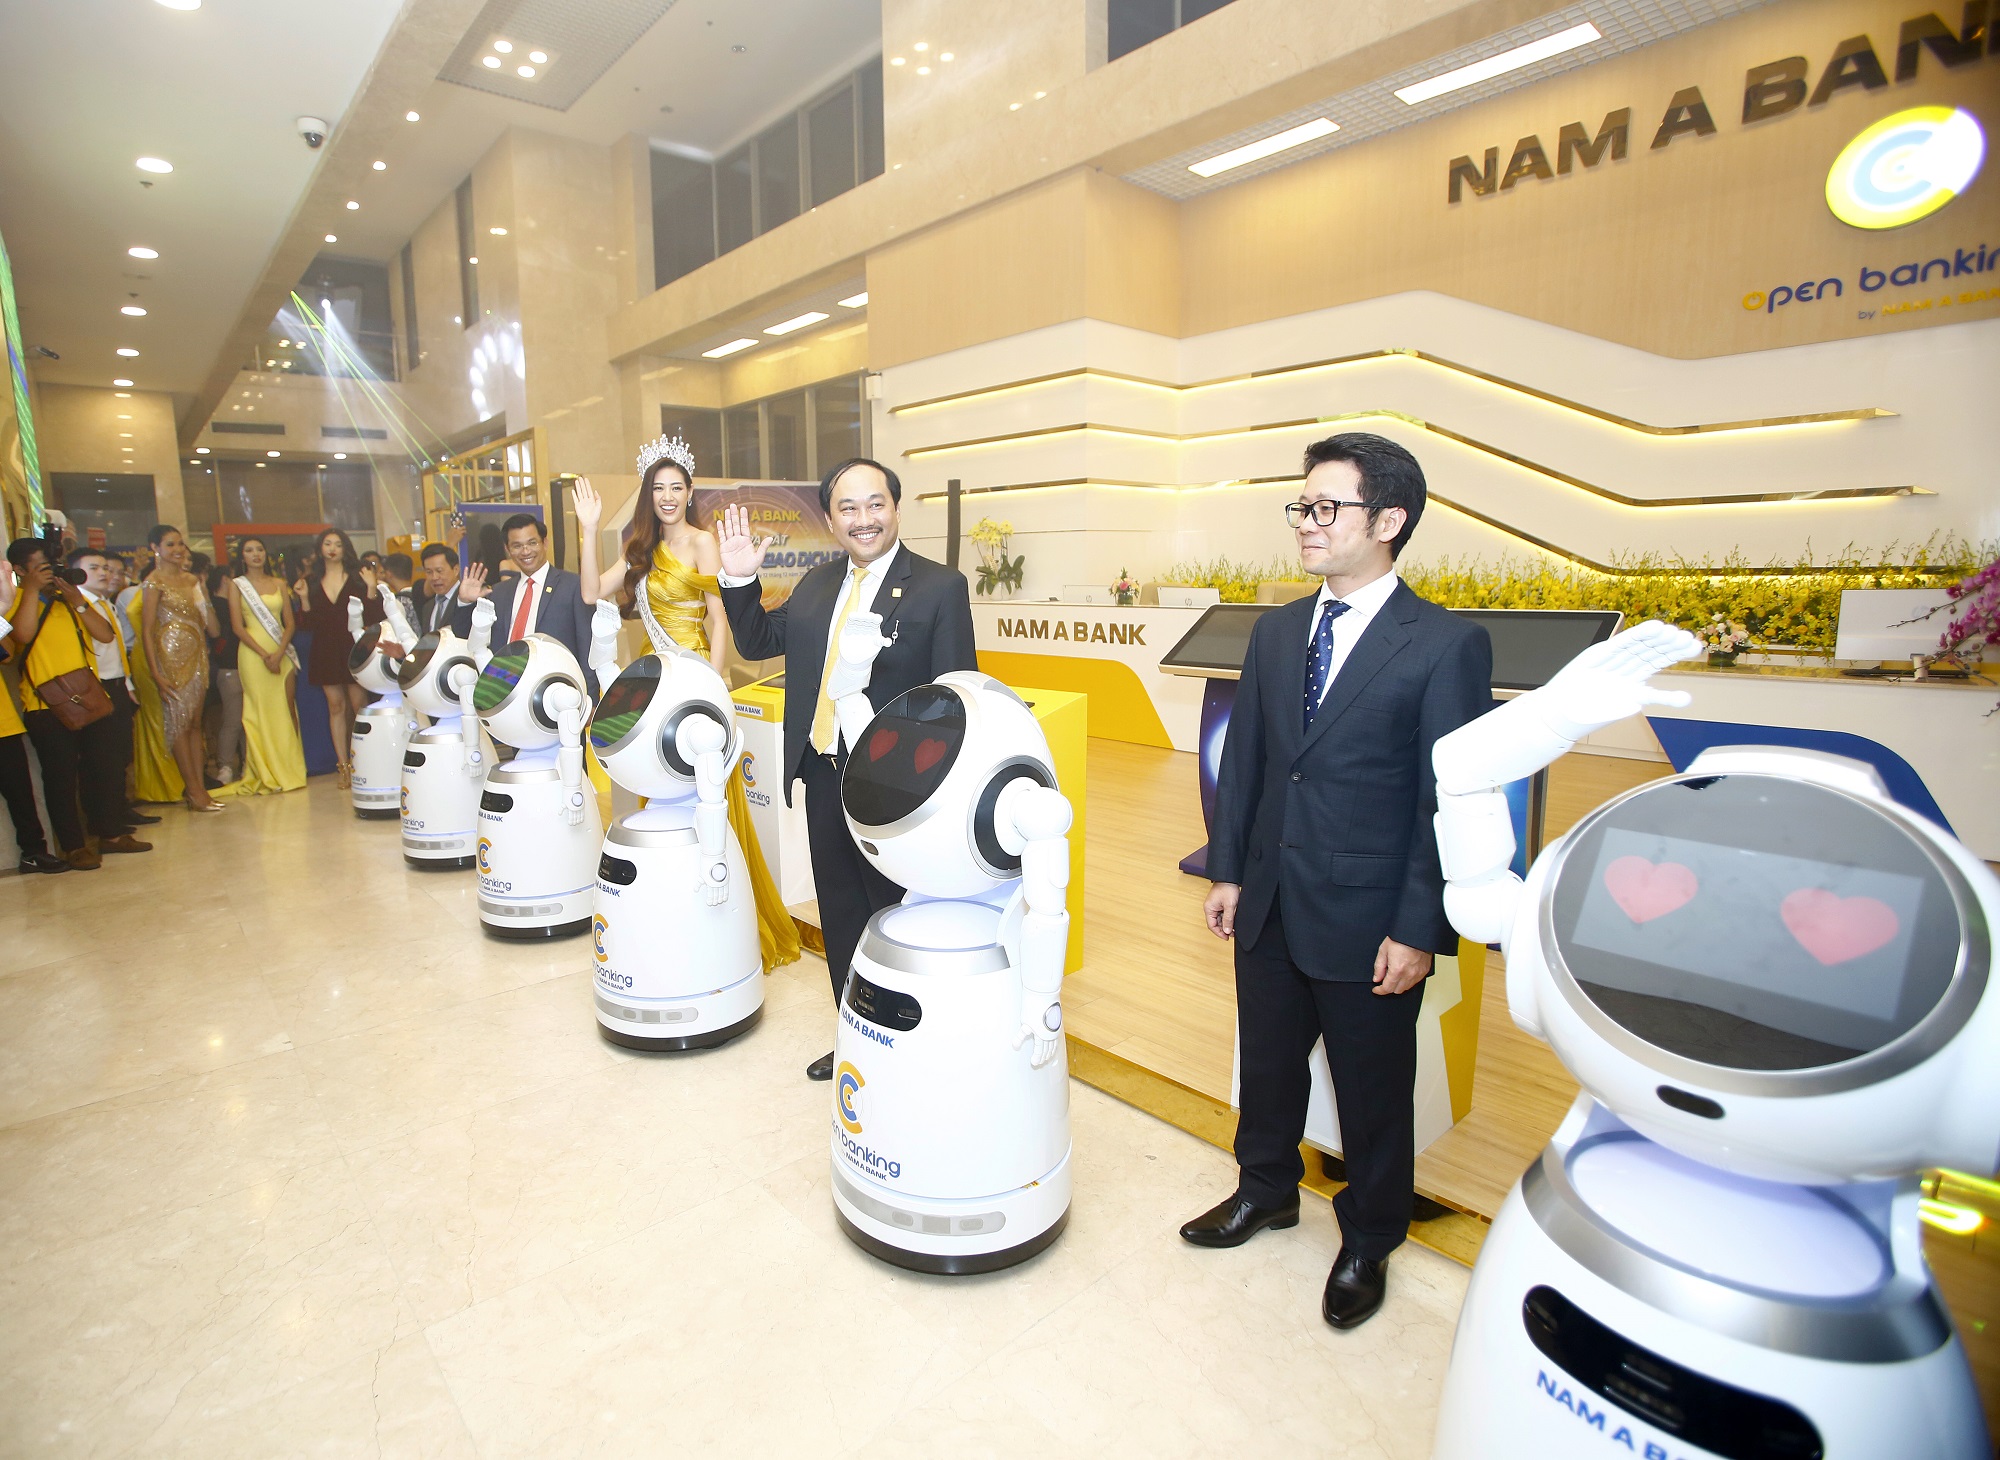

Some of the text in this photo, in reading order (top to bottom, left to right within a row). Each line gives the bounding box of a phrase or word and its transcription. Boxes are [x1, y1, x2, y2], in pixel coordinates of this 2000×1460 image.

[1448, 107, 1631, 203] NAM
[1650, 85, 1717, 150] A
[1742, 277, 1842, 314] open
[1858, 310, 1876, 320] by
[1882, 299, 1932, 316] NAM
[763, 509, 801, 522] BANK
[997, 617, 1147, 646] NAM A BANK
[602, 884, 621, 897] BANK
[841, 1005, 895, 1049] NAM A BANK
[841, 1128, 900, 1179] banking
[865, 1165, 888, 1181] BANK
[1536, 1368, 1607, 1432] NAM
[1612, 1426, 1634, 1452] A
